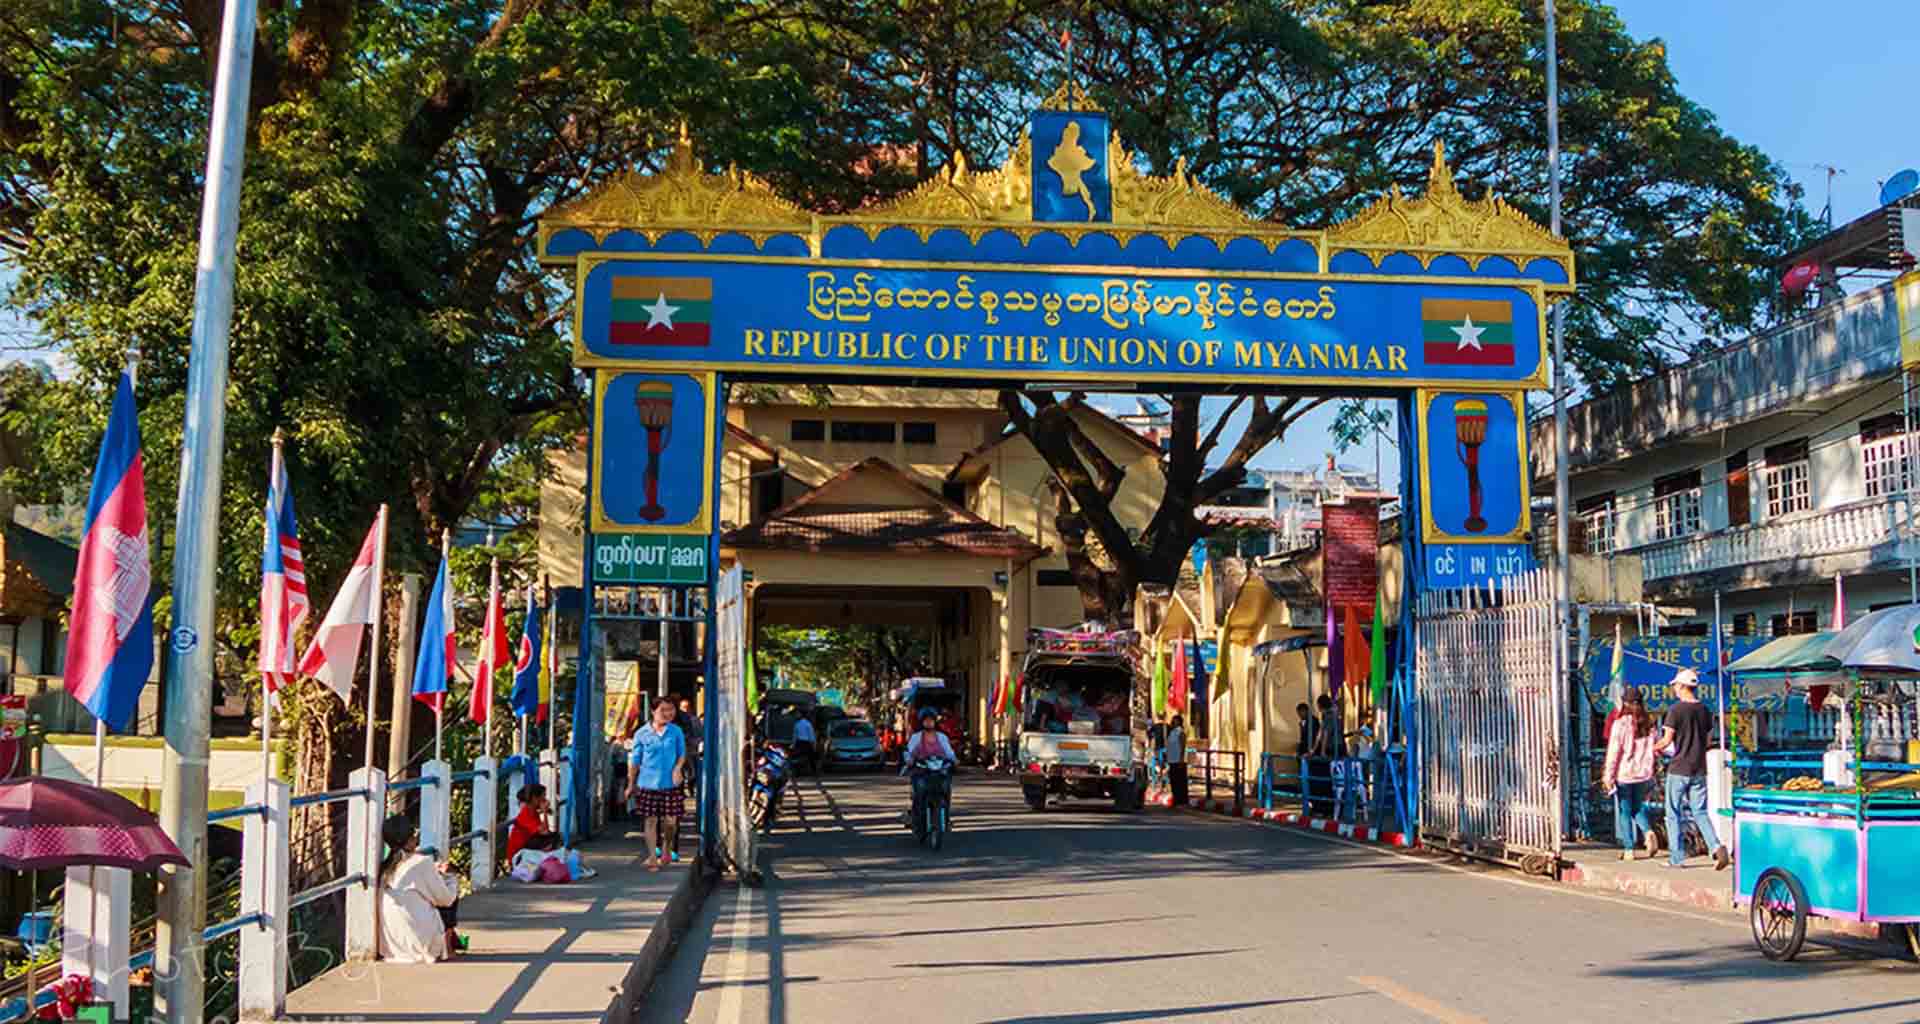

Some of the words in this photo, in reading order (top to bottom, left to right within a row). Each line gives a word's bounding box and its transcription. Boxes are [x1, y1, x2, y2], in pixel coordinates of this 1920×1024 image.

[743, 328, 917, 361] REPUBLIC
[924, 333, 970, 361] OF
[978, 335, 1049, 363] THE
[1058, 336, 1168, 365] UNION
[1178, 339, 1222, 367] OF
[1234, 340, 1409, 371] MYANMAR
[634, 545, 666, 566] OUT
[1471, 556, 1486, 575] IN
[1644, 647, 1681, 664] THE
